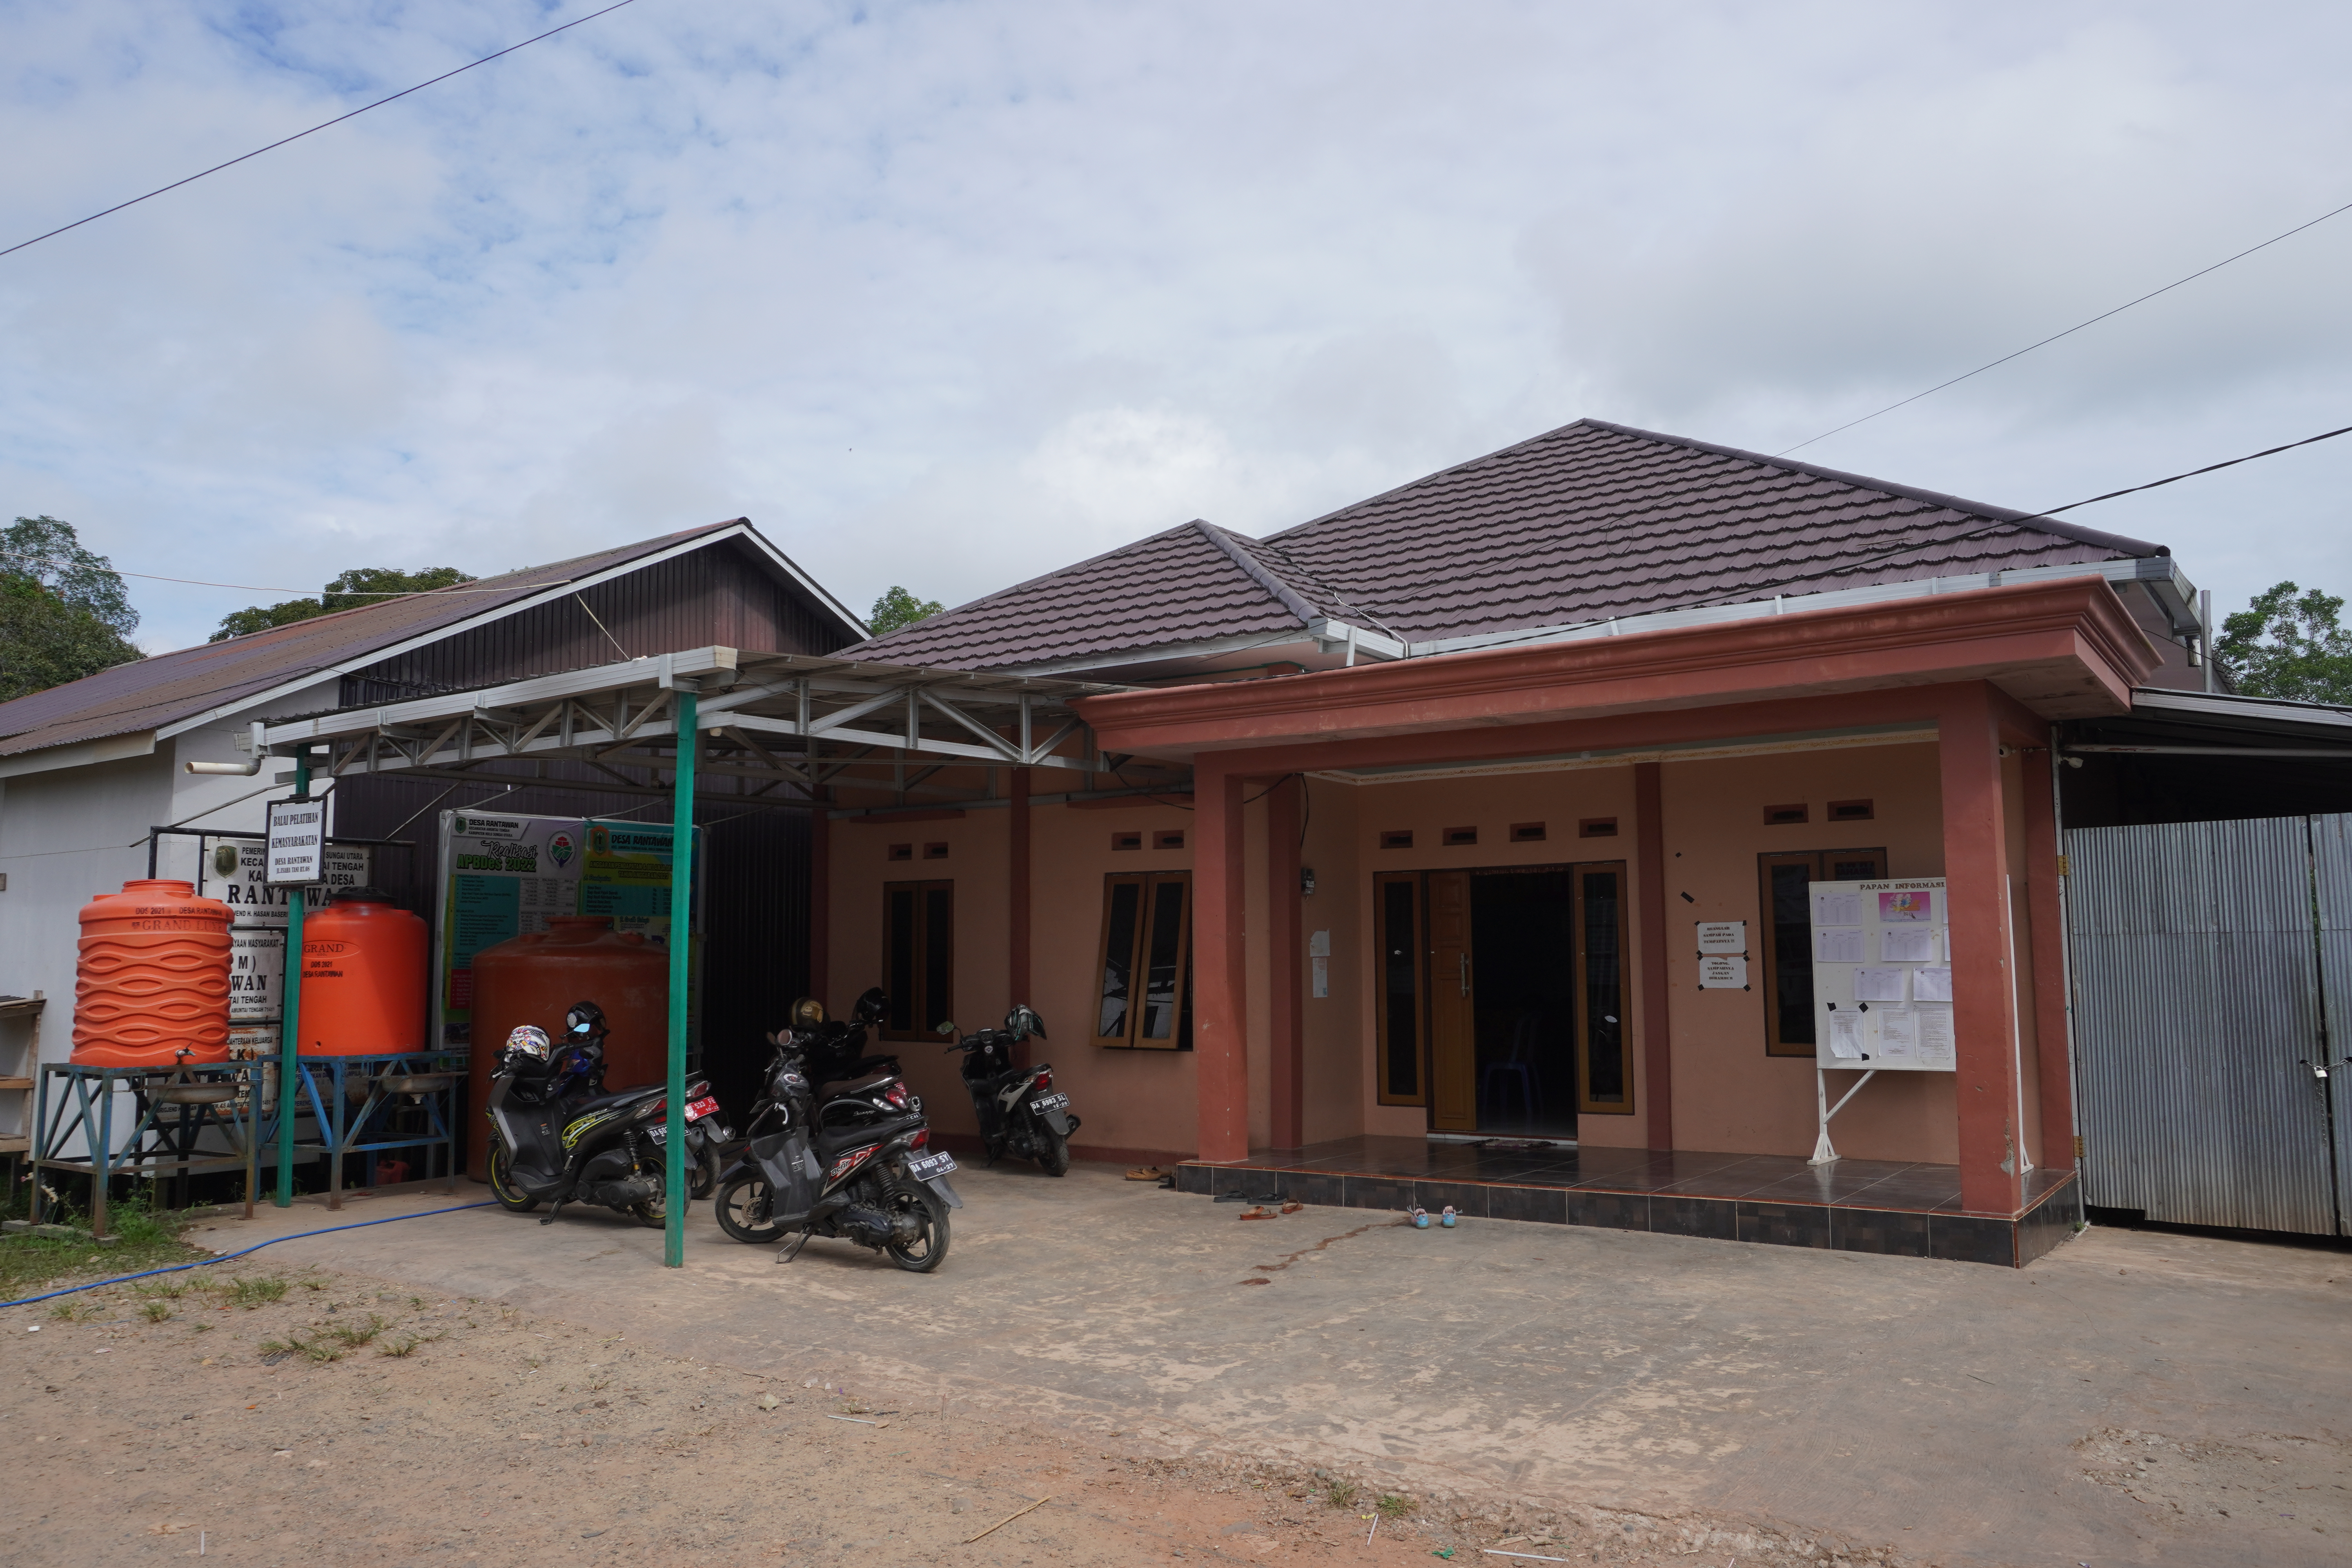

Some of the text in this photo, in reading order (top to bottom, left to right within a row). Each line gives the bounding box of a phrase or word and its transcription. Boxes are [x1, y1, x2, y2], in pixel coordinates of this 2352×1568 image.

[273, 812, 318, 827] BALAI PELATIHAN
[486, 820, 519, 828] RANTAWAN
[271, 835, 318, 848] KEMASYARAKATAN
[612, 835, 673, 847] DESA RANTAWAN
[481, 840, 539, 859] Realisasi
[288, 856, 313, 865] RANTAWAN
[457, 854, 537, 873] APBDes 2022
[332, 863, 363, 871] TENGAH
[331, 873, 354, 885] DESA
[143, 920, 190, 931] GRAND
[248, 939, 279, 947] MASYARAKAT
[304, 944, 344, 953] GRAND
[694, 1101, 706, 1109] 533
[1042, 1098, 1056, 1106] 6983
[910, 1154, 949, 1172] DA 6093 SY
